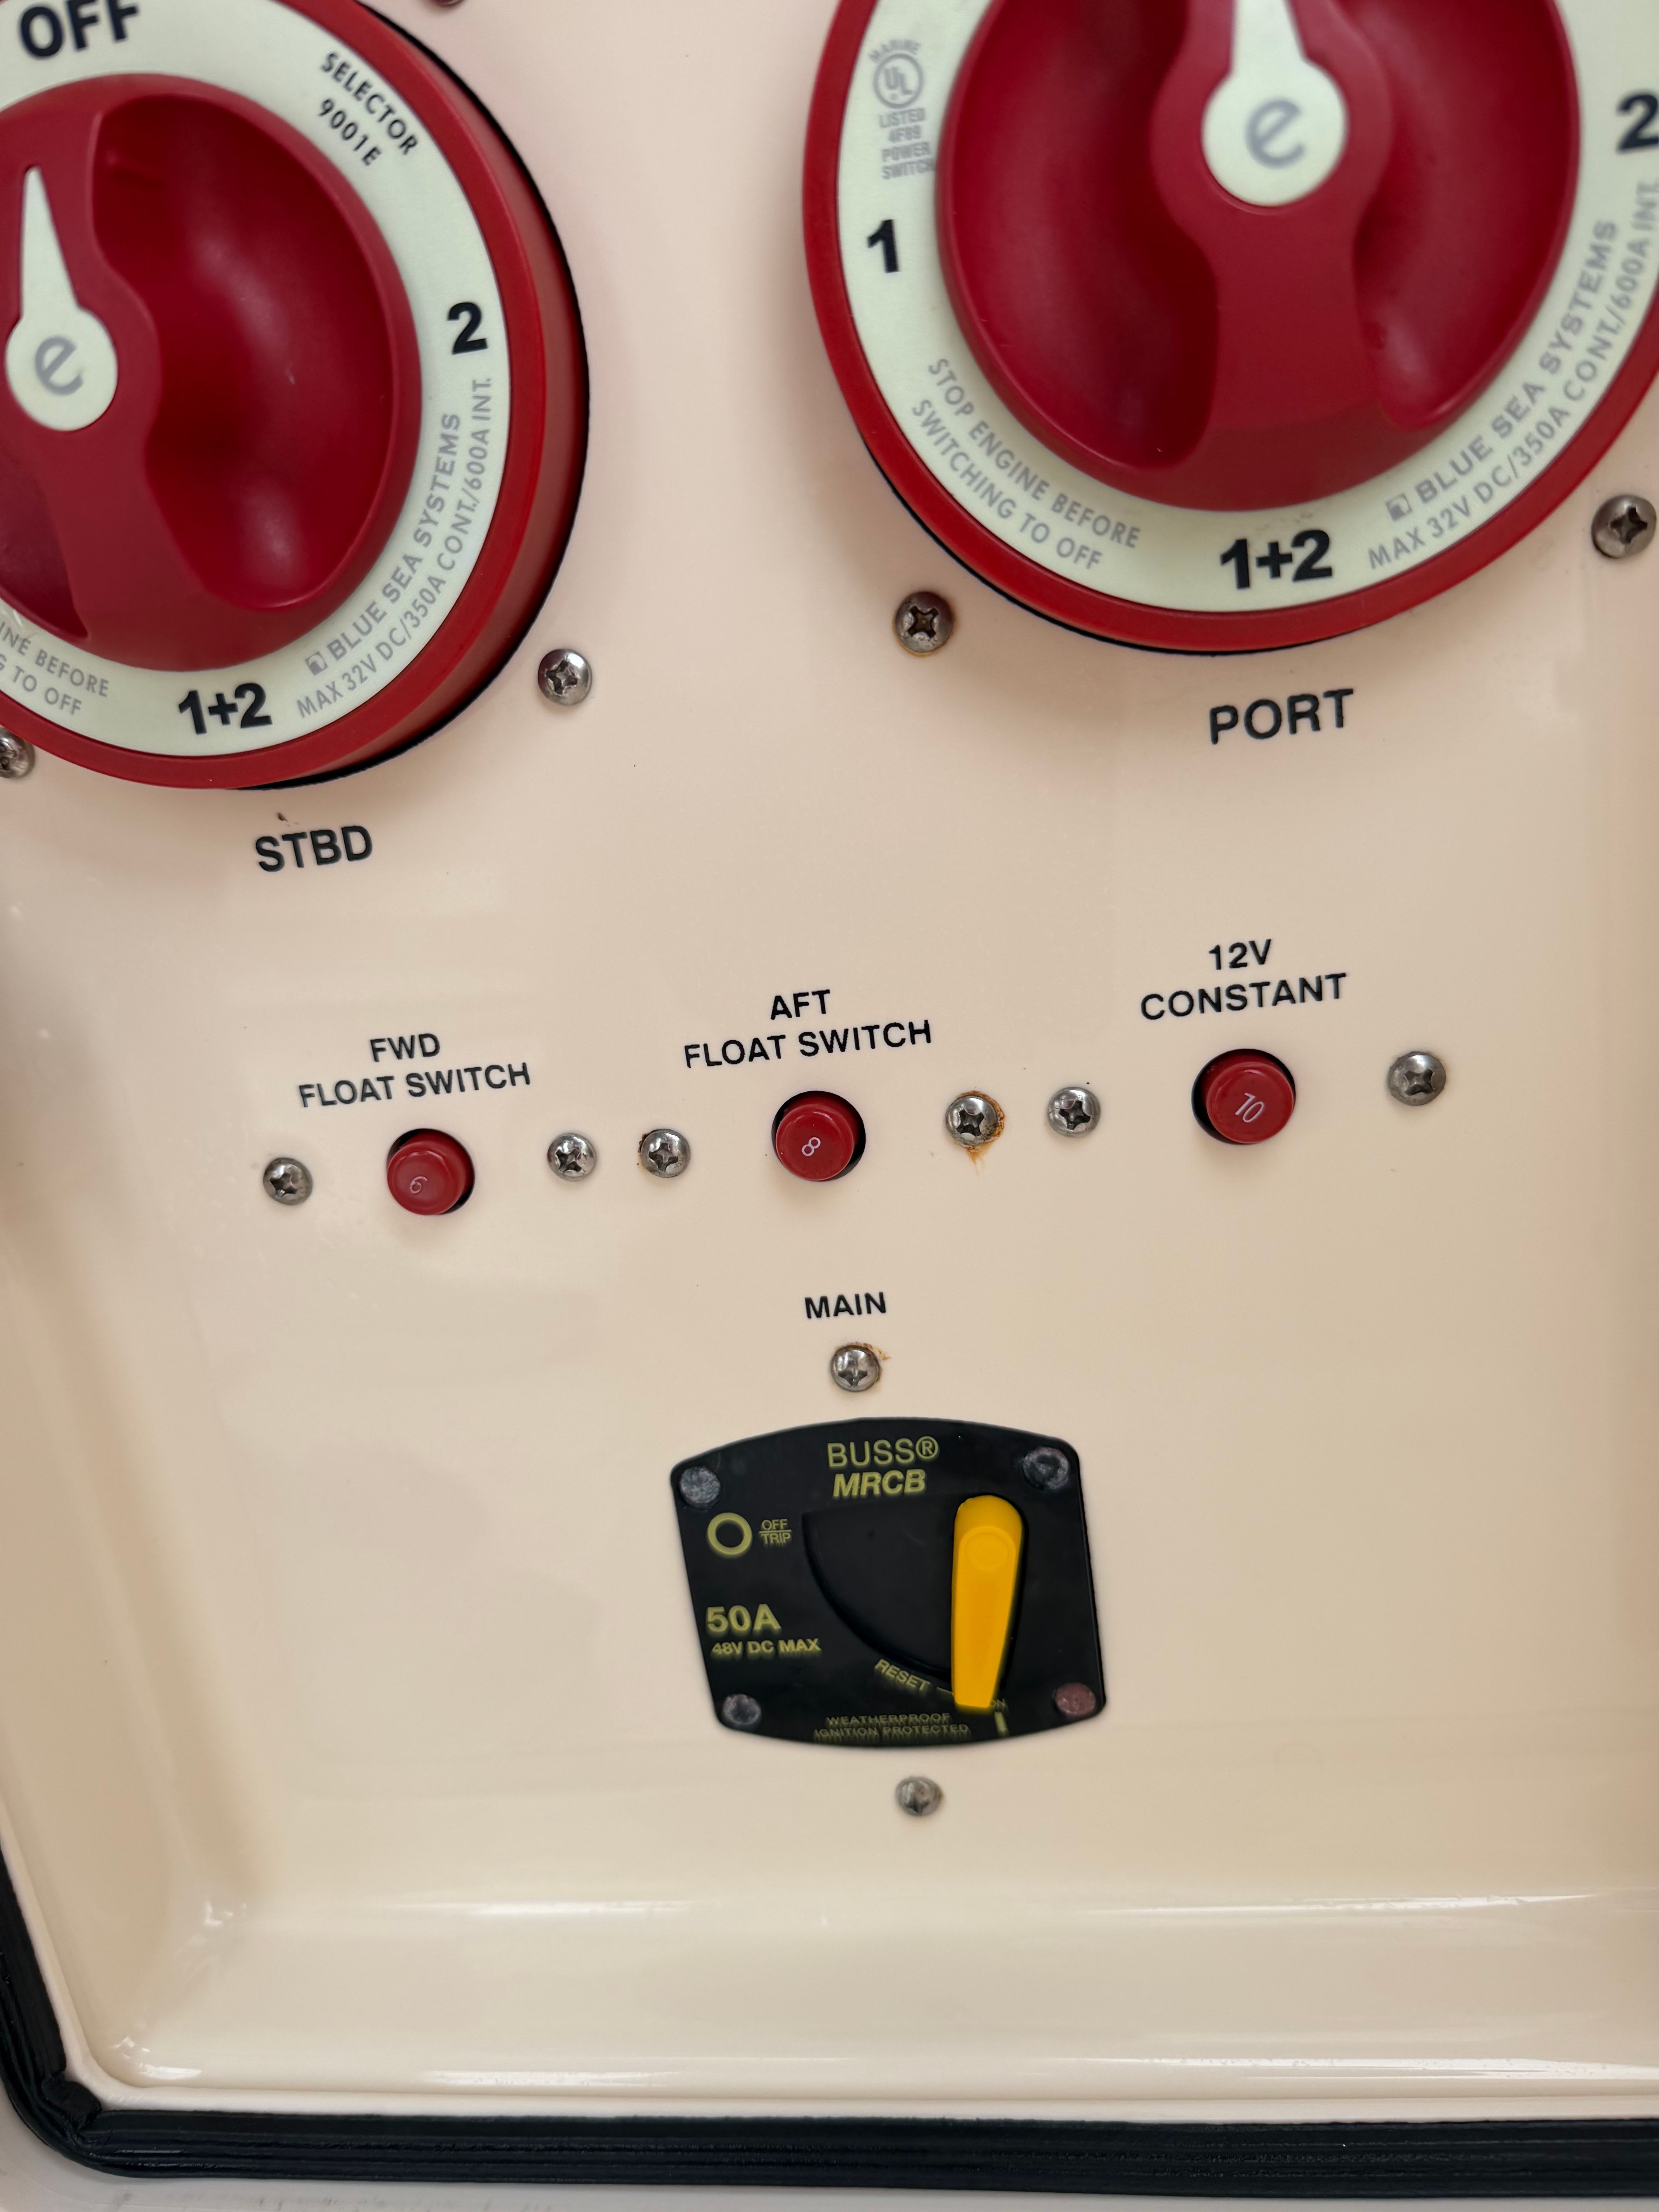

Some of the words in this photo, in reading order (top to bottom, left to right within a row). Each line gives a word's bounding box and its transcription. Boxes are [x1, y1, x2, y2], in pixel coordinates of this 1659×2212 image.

[19, 0, 139, 58] OFF
[321, 52, 418, 156] SELECTOR
[1617, 93, 1659, 154] 2
[318, 98, 382, 166] 9001E
[867, 219, 900, 273] 1
[446, 302, 488, 355] 2
[1414, 434, 1493, 504] BLUE
[1491, 381, 1546, 440] SEA
[1539, 220, 1617, 374] SYSTEMS
[928, 358, 974, 417] STOP
[970, 421, 1049, 500] ENGINE
[1051, 493, 1140, 548] BEFORE
[912, 399, 1018, 519] SWITCHING
[1018, 513, 1049, 544] TO
[1056, 537, 1103, 570] OFF
[1367, 527, 1426, 570] MAX
[1431, 497, 1470, 538] 32V
[1472, 407, 1570, 506] DC/350A
[296, 681, 344, 718] MAX
[343, 653, 377, 691] 32V
[376, 575, 447, 662] DC/350A
[472, 377, 492, 421] INT.
[326, 602, 388, 661] BLUE
[386, 554, 422, 603] SEA
[413, 412, 461, 548] SYSTEMS
[1220, 529, 1332, 590] 1+2
[13, 666, 38, 692] TO
[45, 687, 82, 715] OFF
[35, 649, 109, 697] BEFORE
[179, 682, 272, 735] 1+2
[1209, 688, 1353, 745] PORT
[256, 825, 373, 872] STBD
[1208, 939, 1271, 970] 12V
[771, 989, 830, 1020] AFT
[1140, 972, 1346, 1020] CONSTANT
[370, 1033, 440, 1062] FWD
[684, 1034, 786, 1068] FLOAT
[799, 1019, 931, 1057] SWITCH
[299, 1075, 395, 1108] FLOAT
[406, 1062, 531, 1097] SWITCH
[1235, 1093, 1264, 1123] 10
[802, 1137, 821, 1156] 8
[804, 1291, 886, 1319] MAIN
[833, 1469, 926, 1498] MRCB
[761, 1518, 788, 1530] OFF
[761, 1532, 792, 1545] TRIP
[707, 1603, 782, 1634] 50A
[711, 1641, 743, 1656] 48V
[747, 1640, 775, 1654] DC
[778, 1638, 822, 1654] MAX
[874, 1659, 930, 1692] RESET
[814, 1727, 880, 1740] IGNITION
[882, 1724, 970, 1740] PROTECTED
[826, 1713, 952, 1727] WEATHERPROOF
